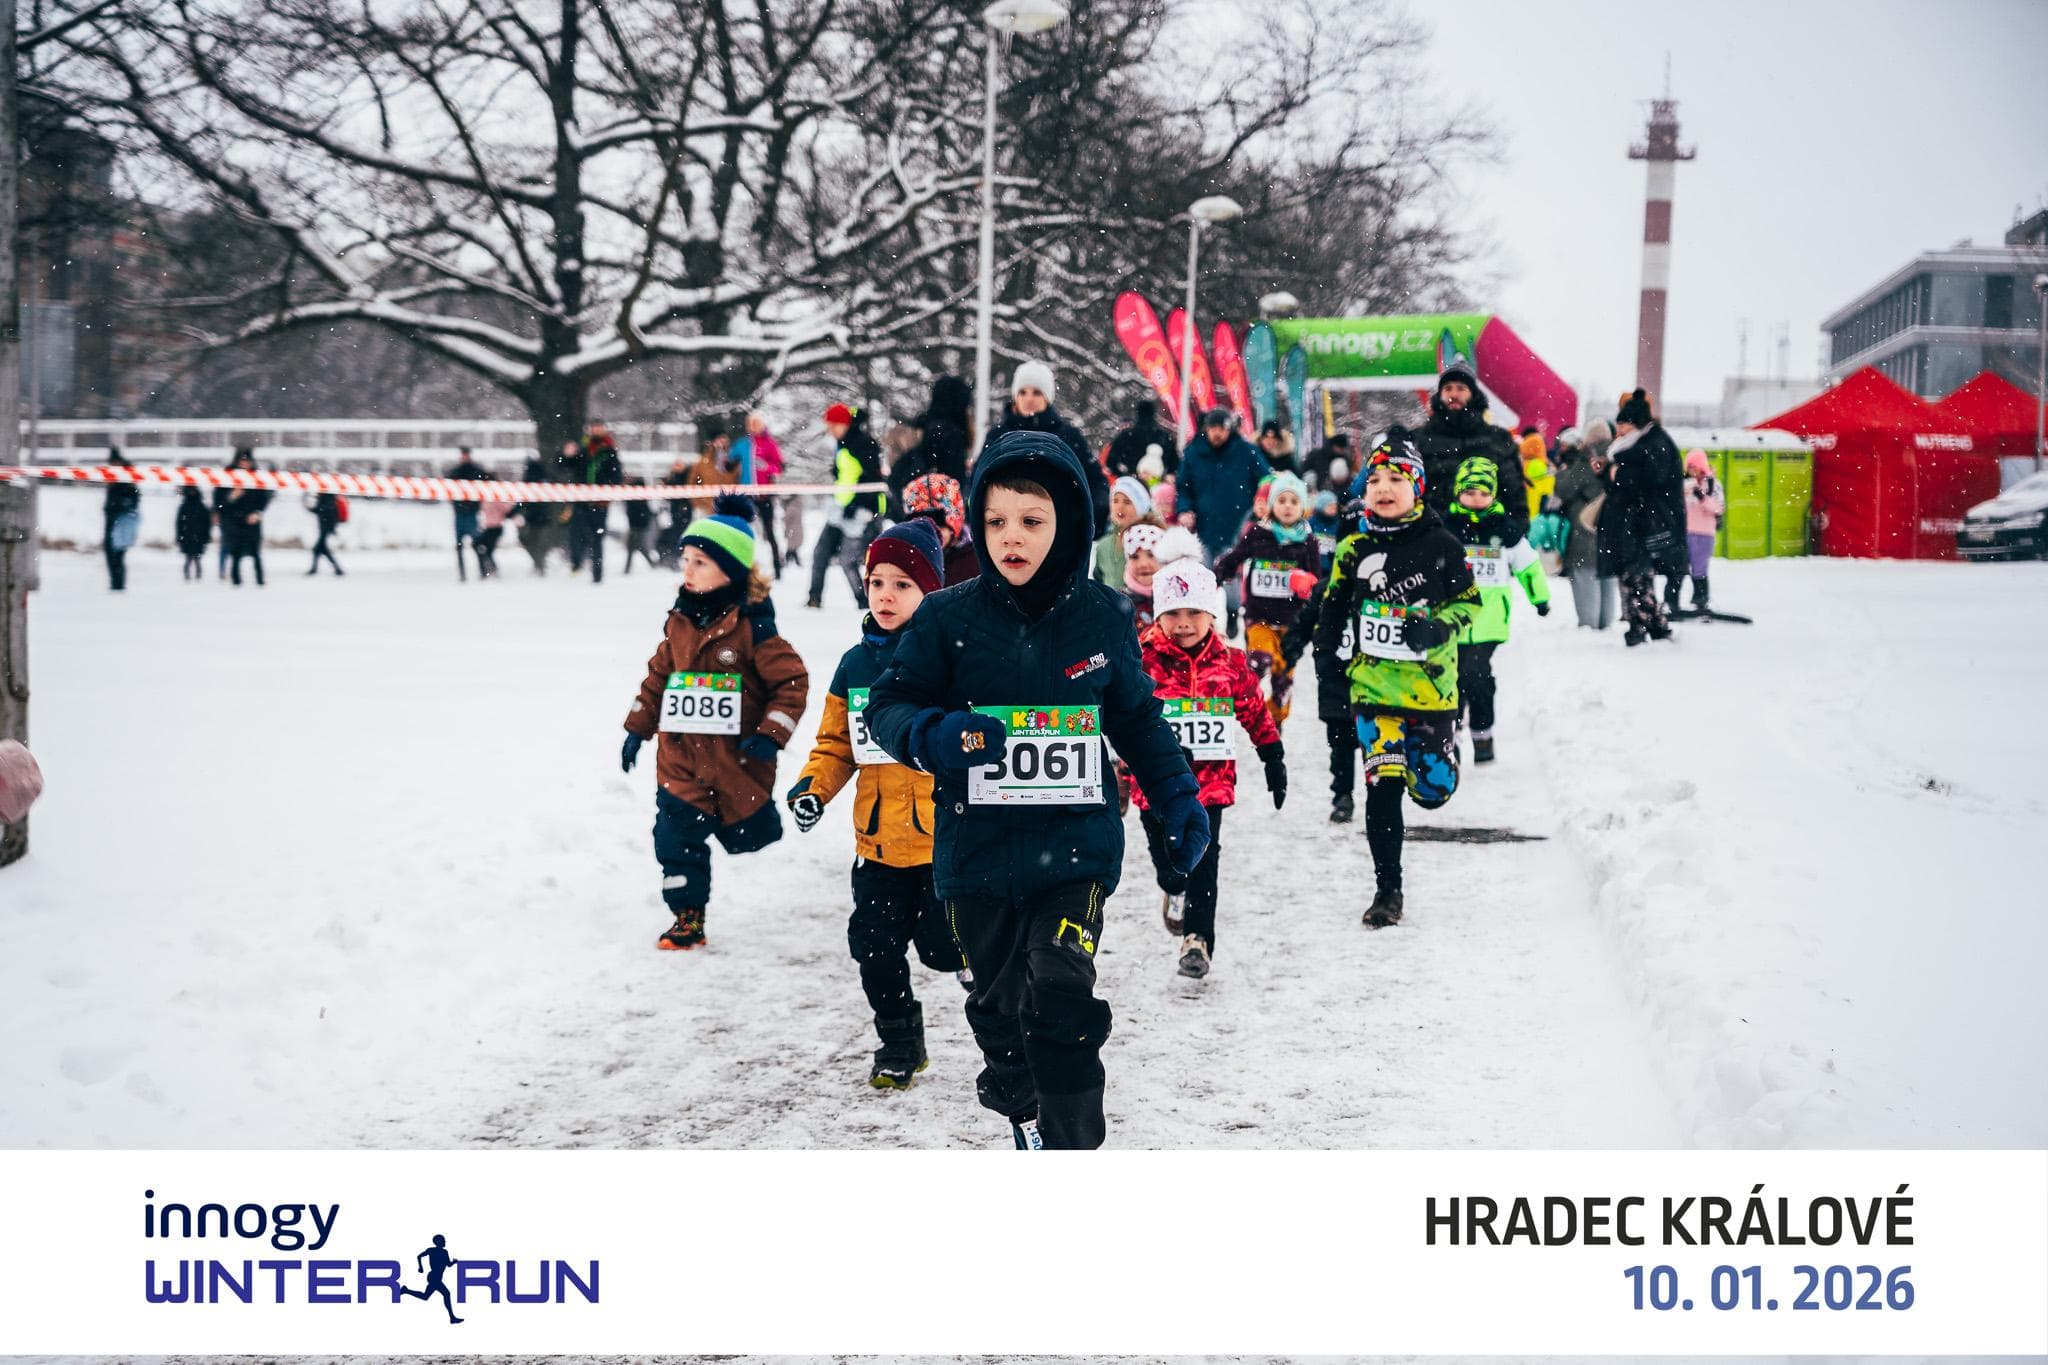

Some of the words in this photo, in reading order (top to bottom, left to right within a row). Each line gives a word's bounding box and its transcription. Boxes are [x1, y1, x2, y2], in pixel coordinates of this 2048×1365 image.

[1300, 328, 1432, 360] innogy.cz
[1914, 433, 1973, 450] NUTREND
[1476, 562, 1496, 576] 28
[1375, 572, 1427, 603] DIATOR
[1365, 620, 1406, 646] 303
[1089, 652, 1105, 667] PRO
[667, 695, 733, 718] 3086
[983, 742, 1086, 780] 3061
